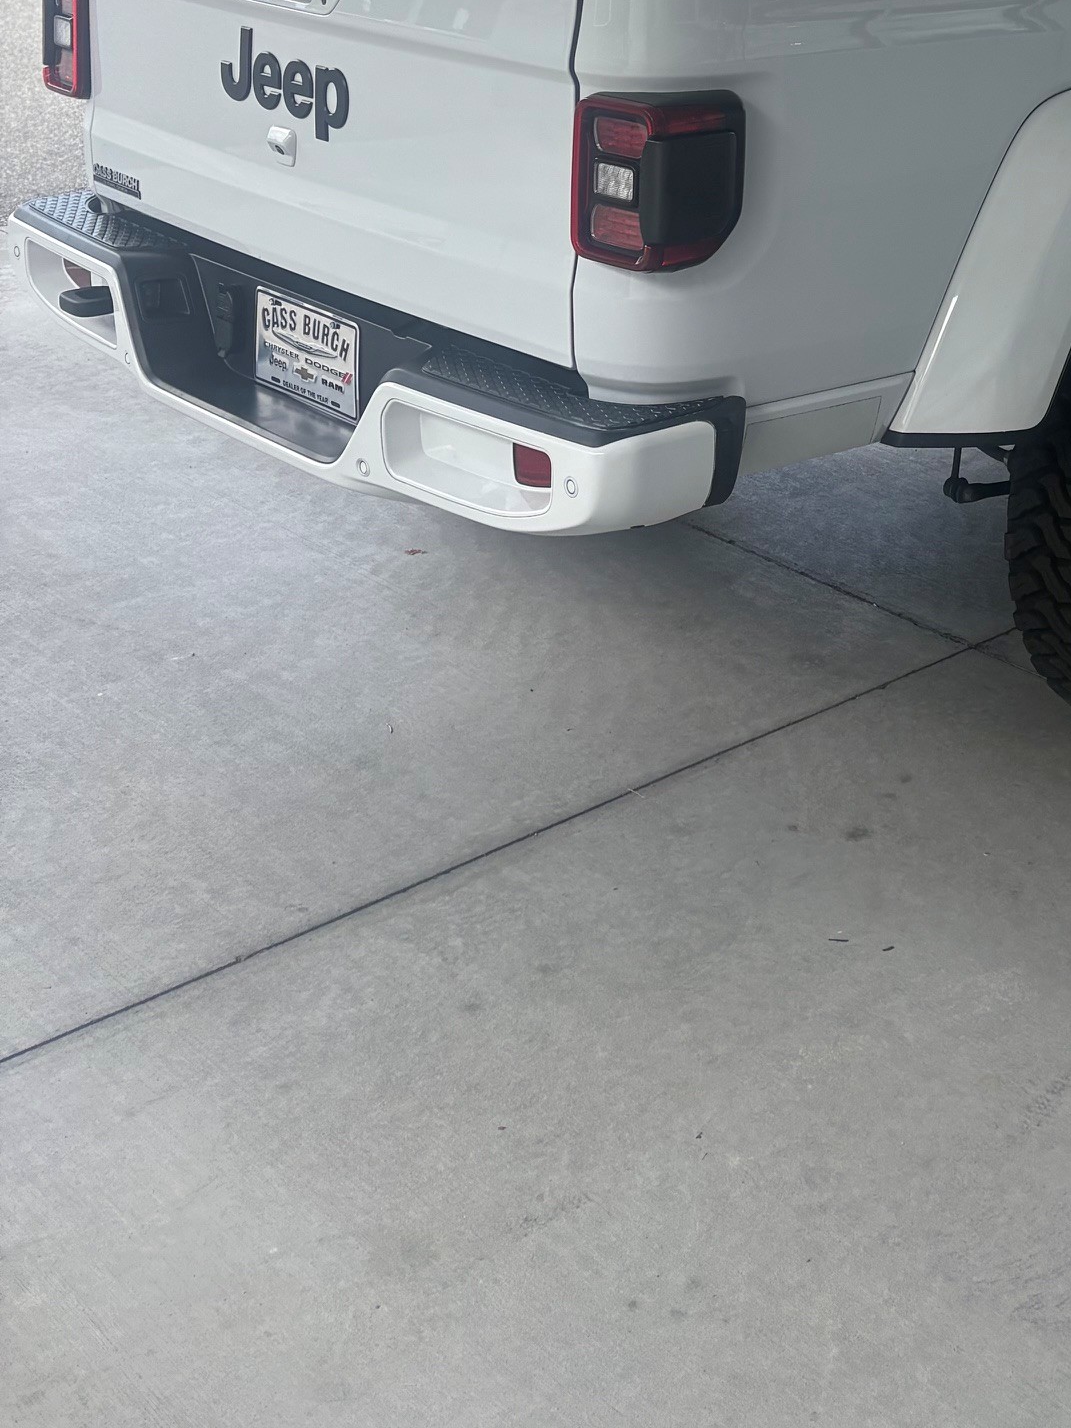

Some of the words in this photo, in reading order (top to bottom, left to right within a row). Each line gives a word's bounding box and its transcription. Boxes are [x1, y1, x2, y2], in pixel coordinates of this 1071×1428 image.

[221, 25, 349, 143] Jeep
[112, 171, 140, 191] BURCH
[262, 307, 297, 332] CASS
[303, 314, 350, 362] BURCH
[264, 340, 300, 361] CHRYSLER
[305, 357, 344, 379] DODGE
[269, 353, 288, 372] Jeep
[321, 378, 345, 393] RAM
[282, 380, 300, 392] DEALER
[300, 386, 308, 394] OF
[307, 388, 316, 399] THE
[316, 393, 329, 404] YEAR
